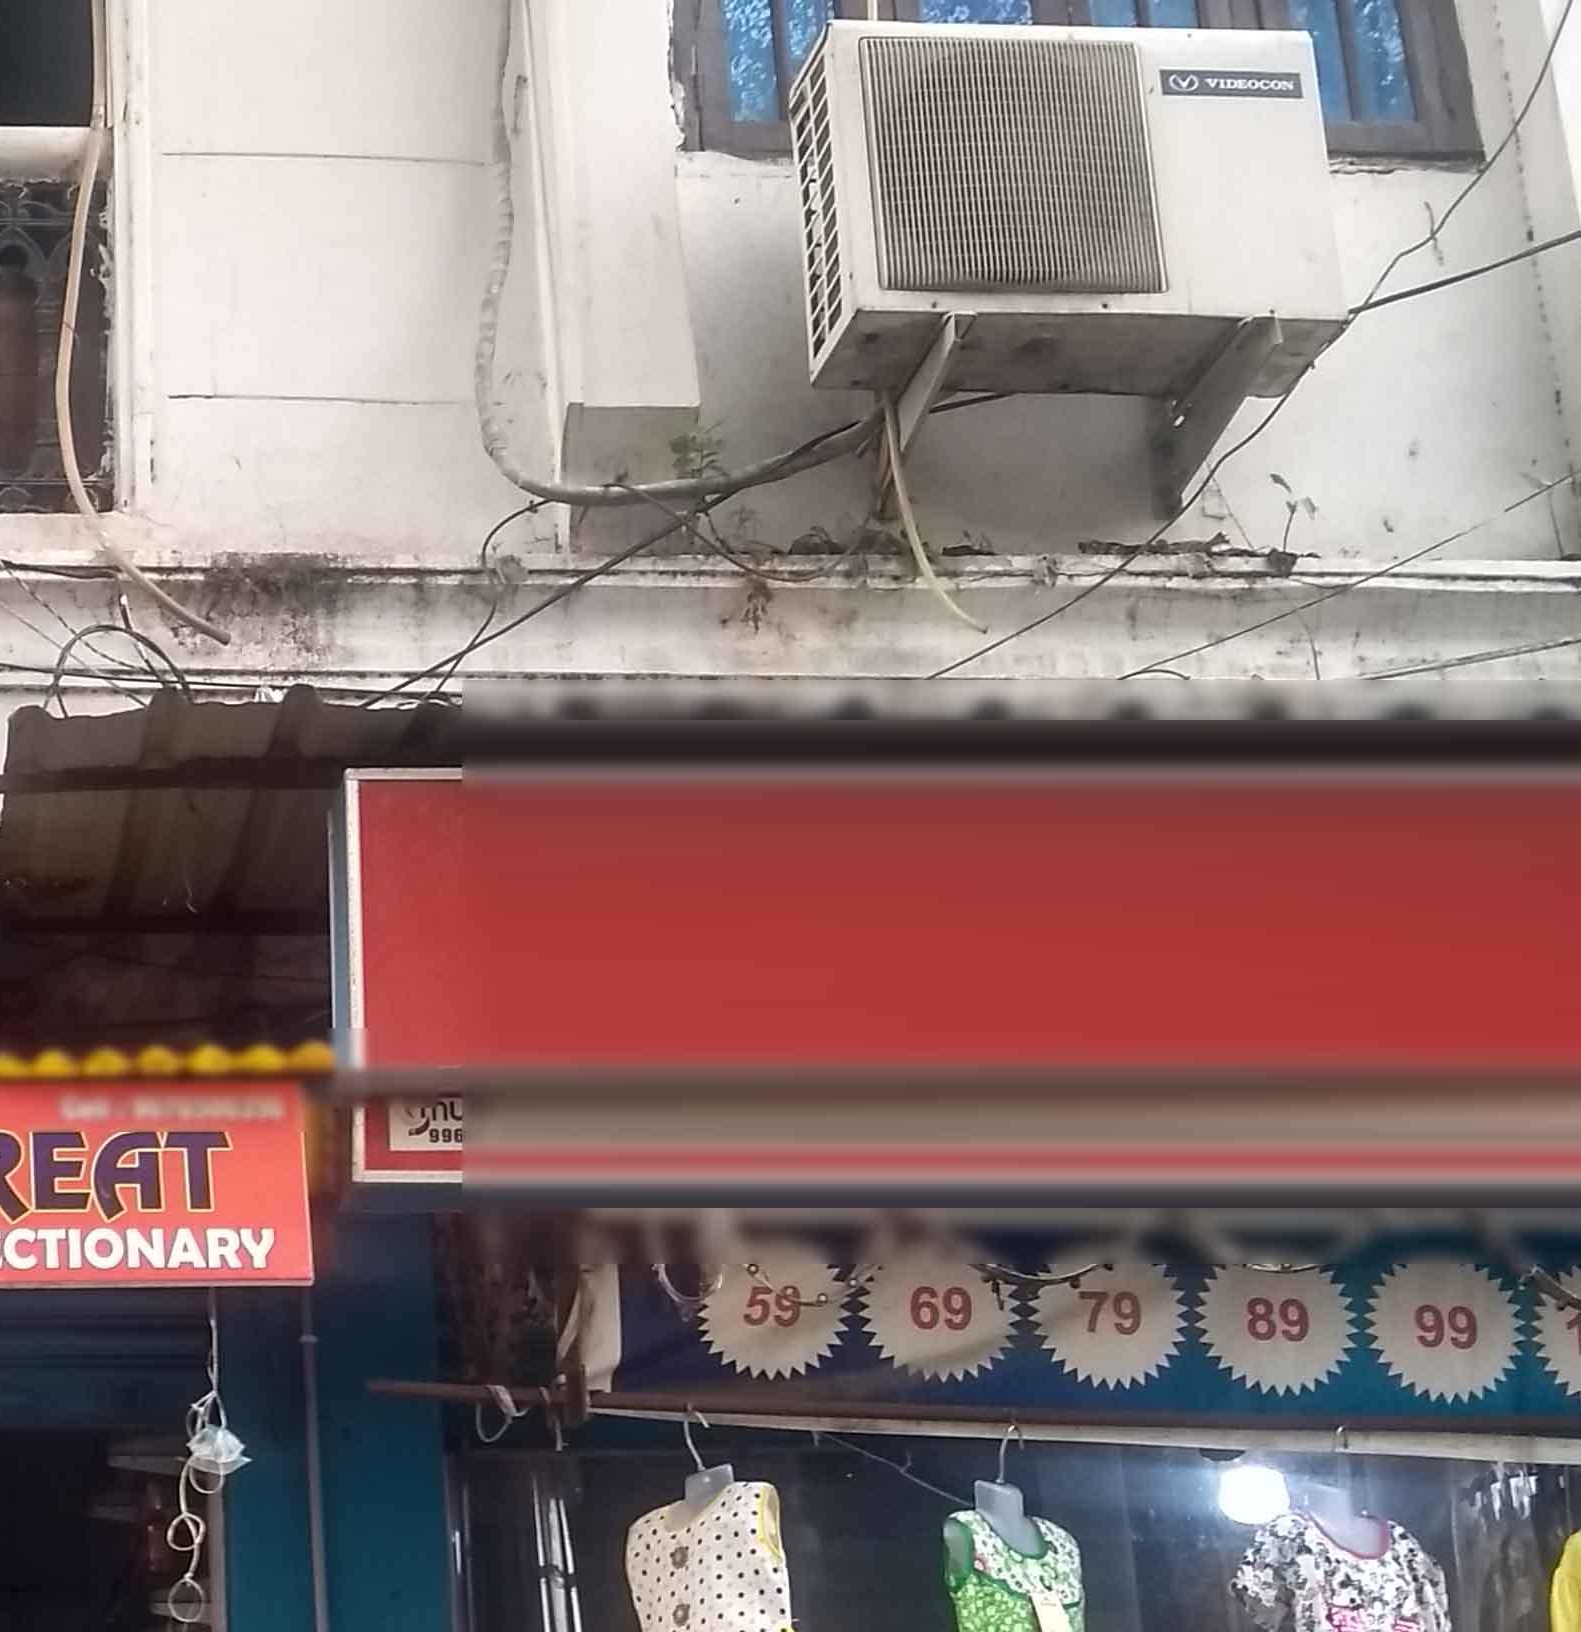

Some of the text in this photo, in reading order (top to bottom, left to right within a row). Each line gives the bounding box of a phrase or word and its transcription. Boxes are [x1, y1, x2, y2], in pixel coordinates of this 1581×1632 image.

[1204, 77, 1295, 91] VIDEOCON
[743, 1285, 803, 1328] 59
[910, 1285, 973, 1331] 69
[1078, 1290, 1143, 1336] 79
[1247, 1296, 1310, 1342] 89
[1415, 1304, 1478, 1350] 99
